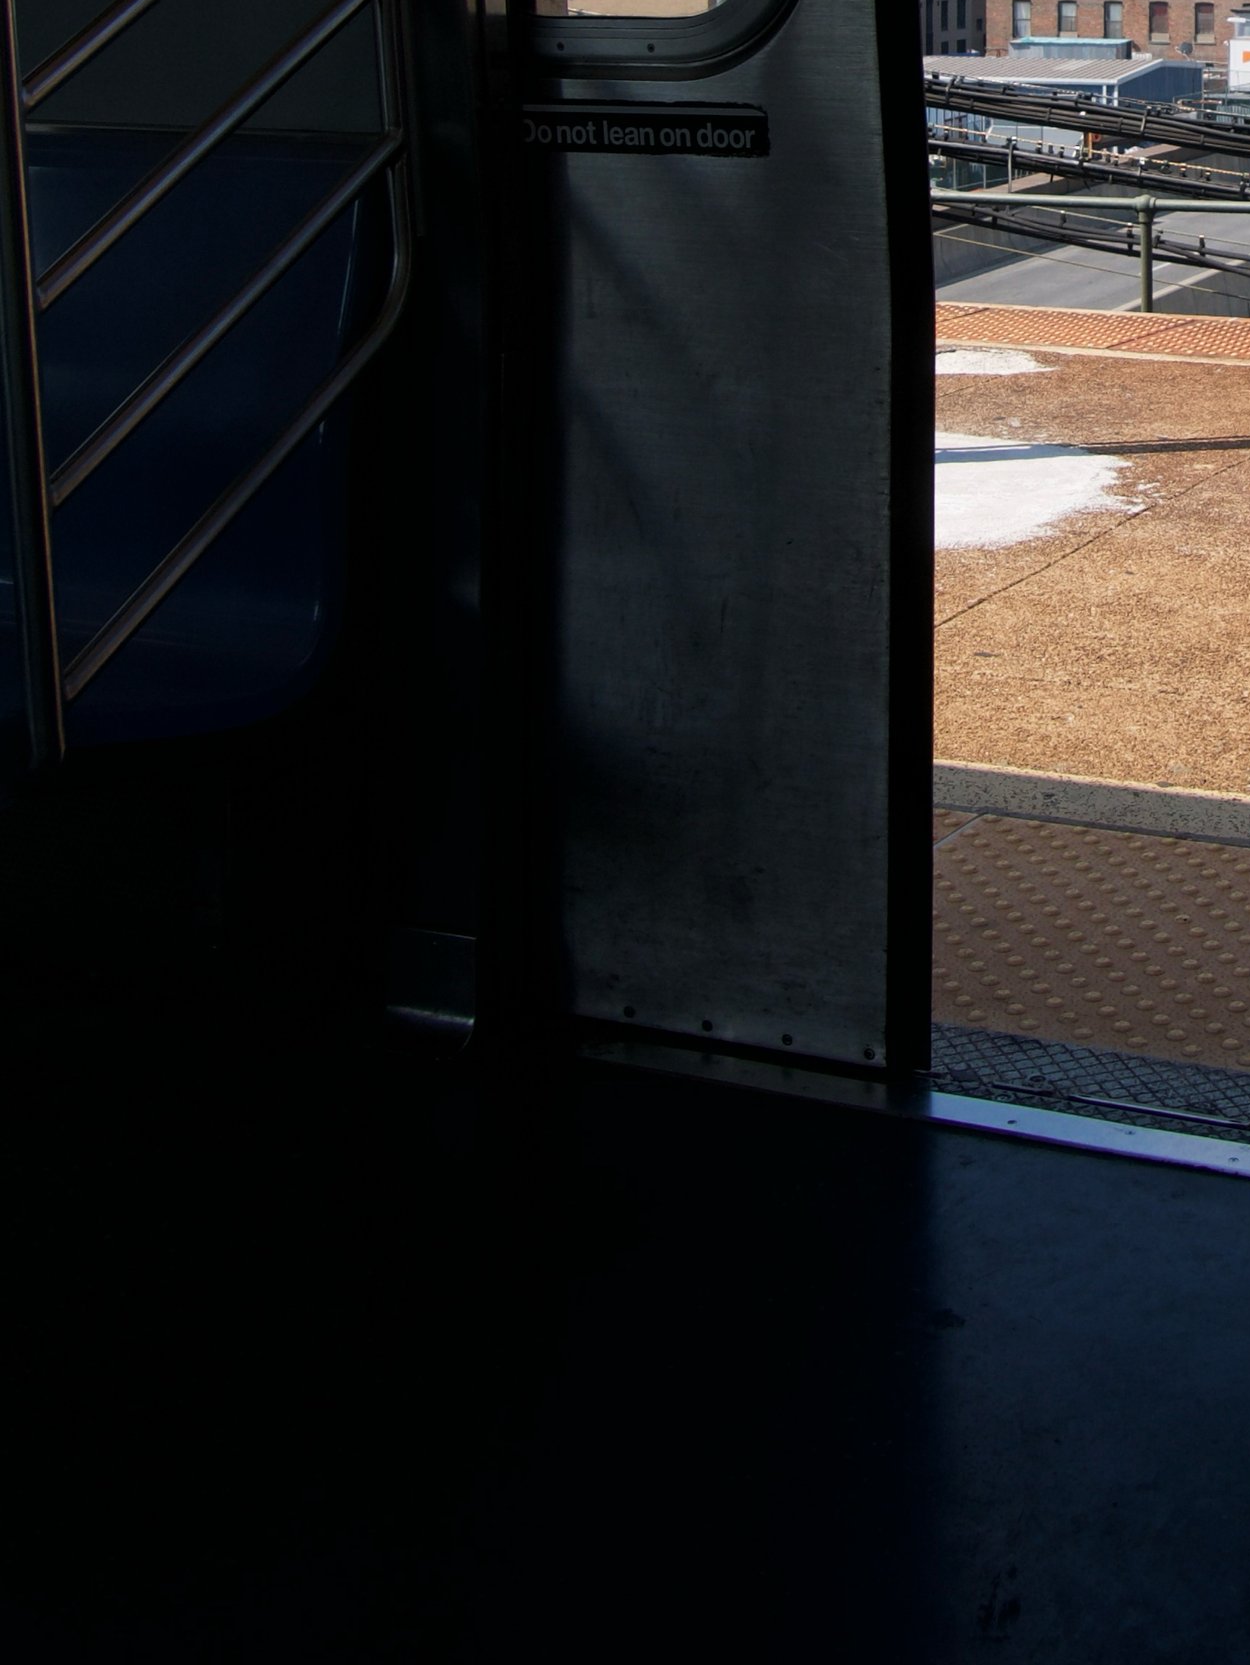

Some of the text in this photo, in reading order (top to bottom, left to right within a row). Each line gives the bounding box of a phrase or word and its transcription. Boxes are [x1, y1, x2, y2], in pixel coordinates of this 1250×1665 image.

[555, 121, 598, 144] not
[603, 120, 654, 146] lean
[660, 127, 692, 148] on
[697, 122, 755, 148] door
